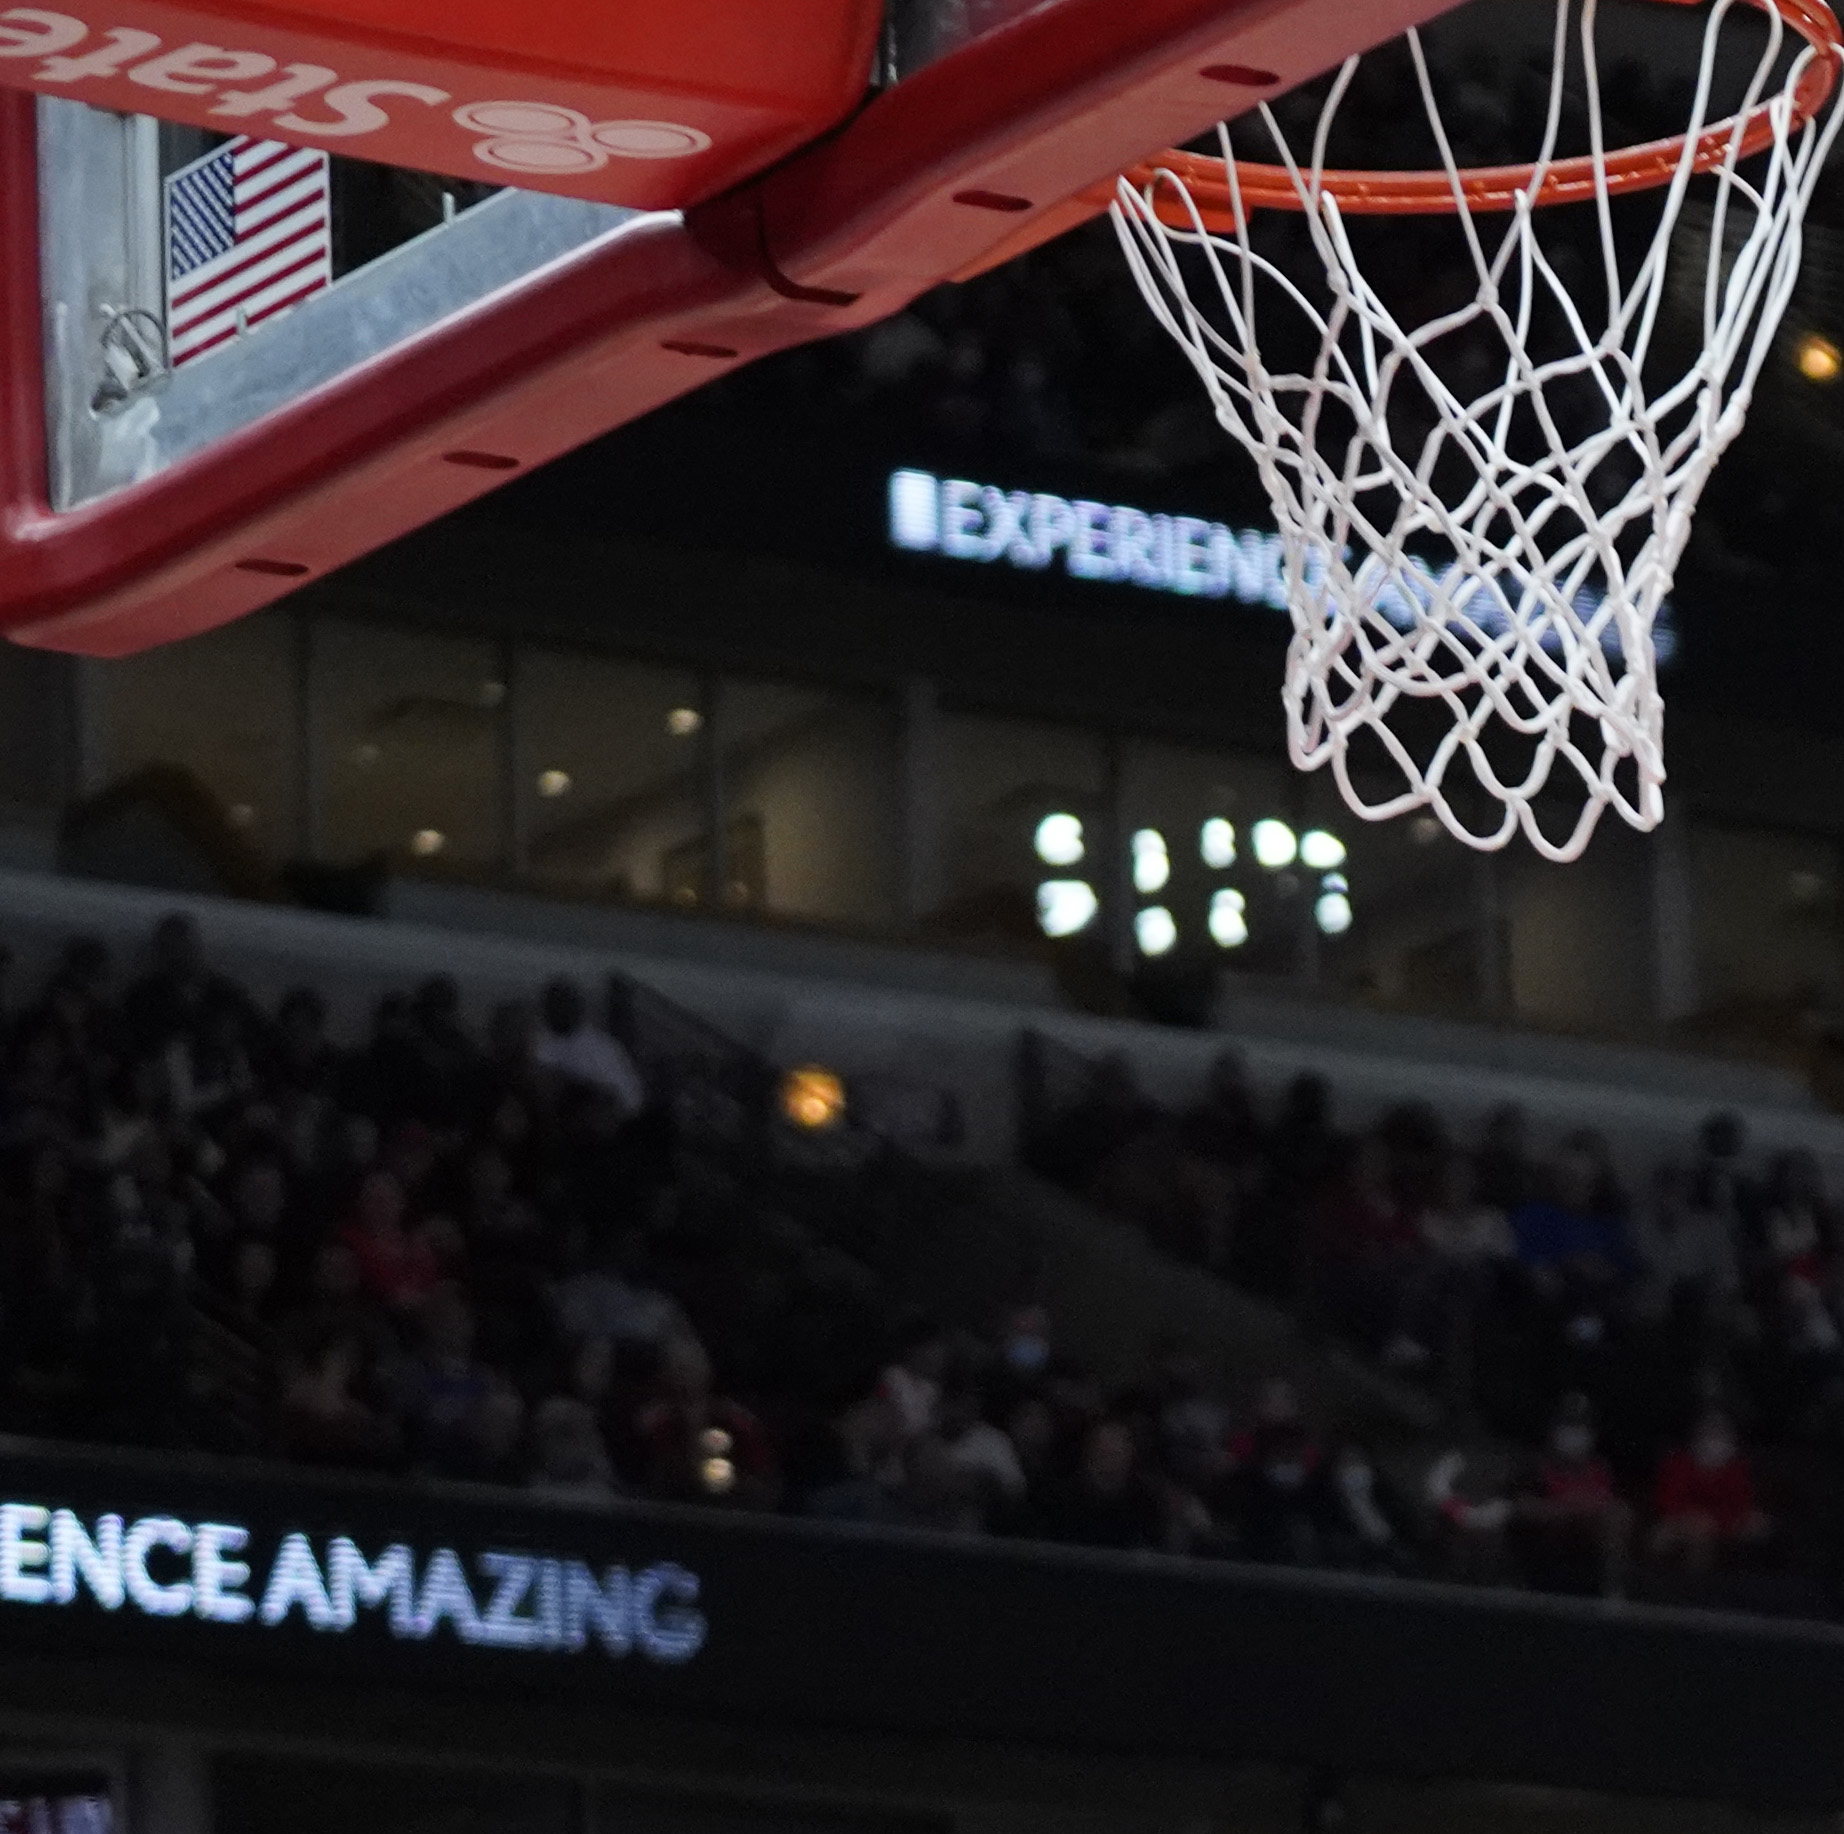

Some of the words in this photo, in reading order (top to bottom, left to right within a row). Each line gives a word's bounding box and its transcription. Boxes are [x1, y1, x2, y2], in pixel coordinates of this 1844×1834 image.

[0, 8, 451, 137] State
[0, 1502, 256, 1622] ENCE
[258, 1530, 708, 1665] AMAZING
